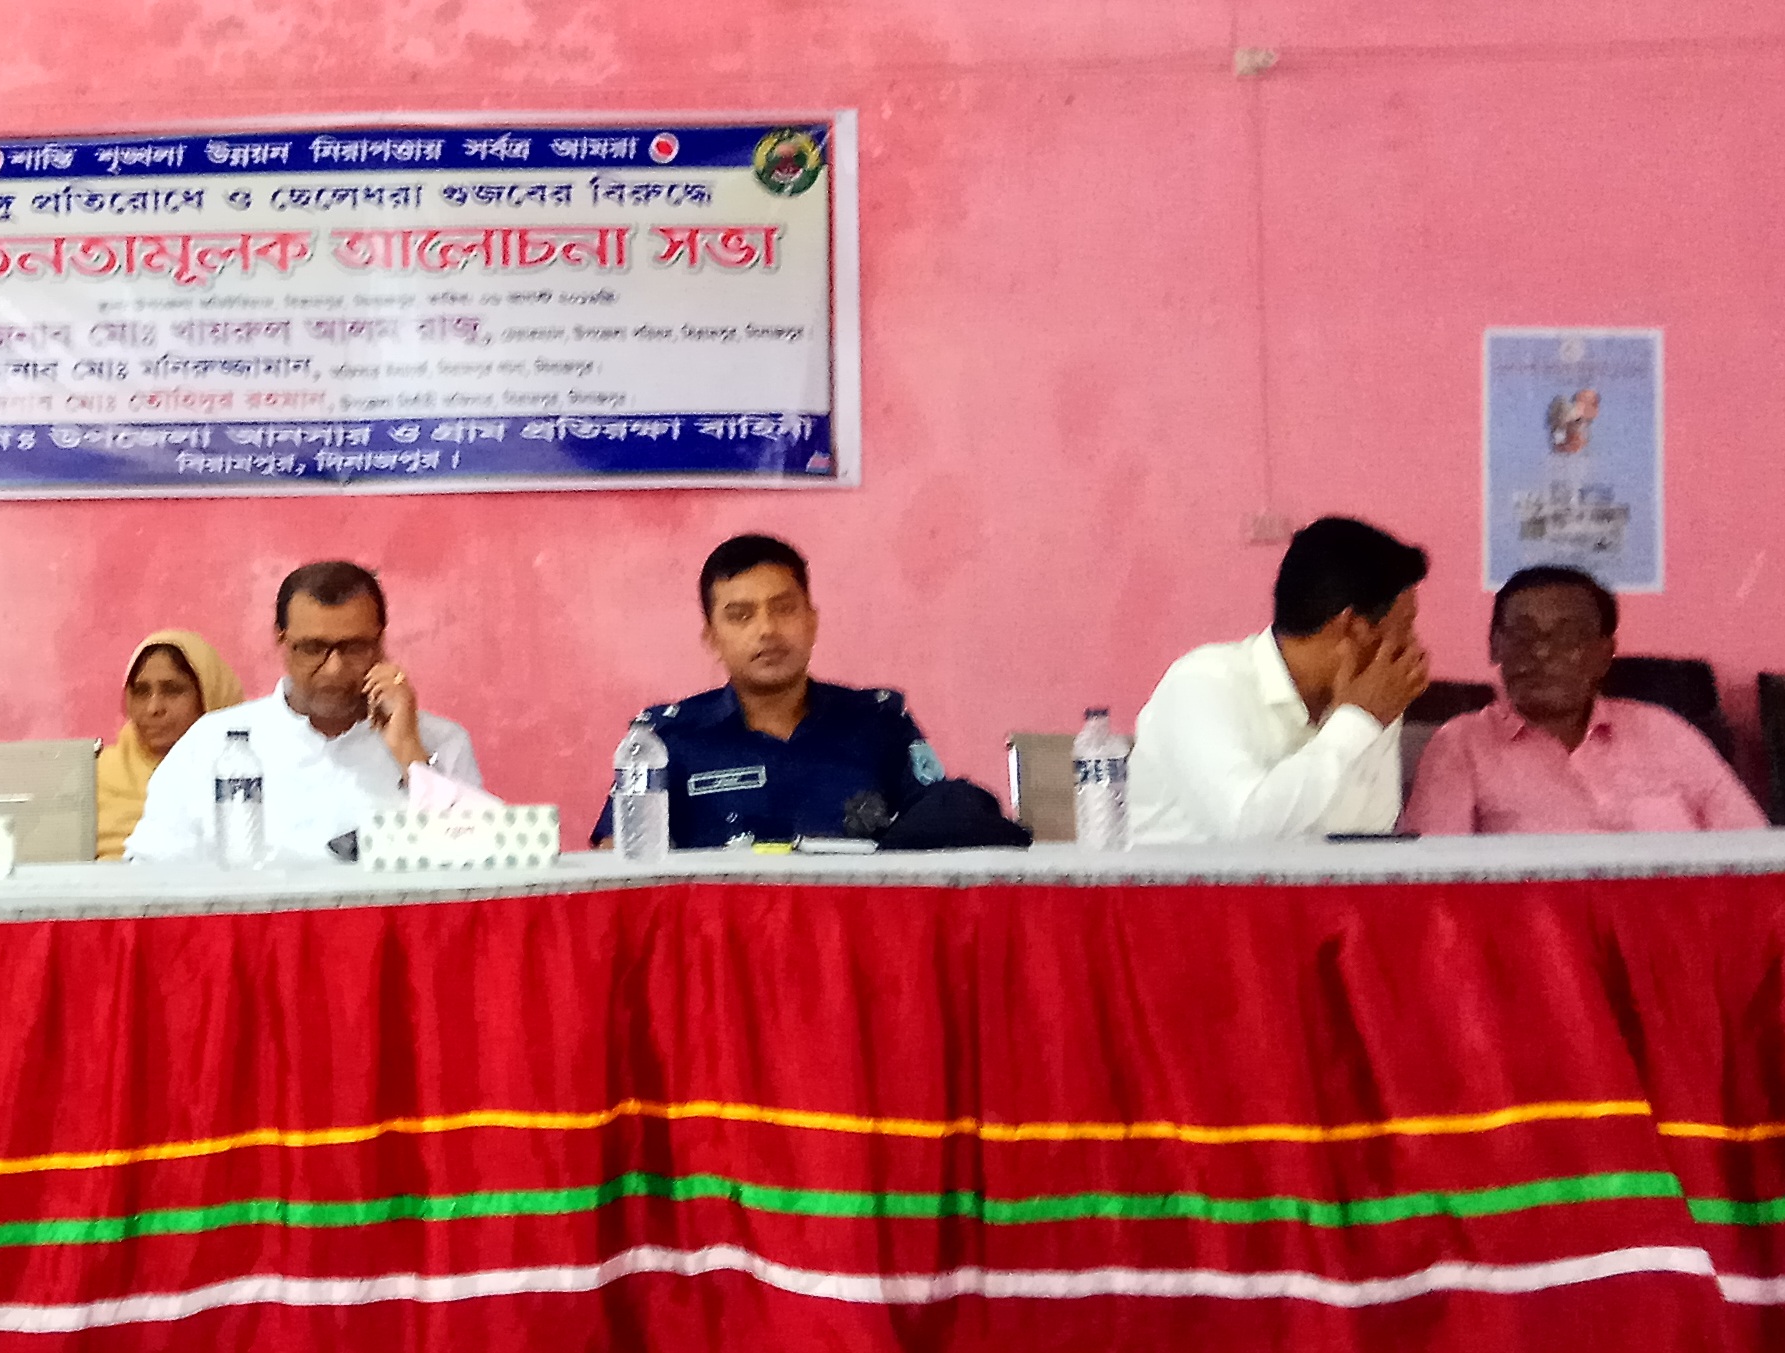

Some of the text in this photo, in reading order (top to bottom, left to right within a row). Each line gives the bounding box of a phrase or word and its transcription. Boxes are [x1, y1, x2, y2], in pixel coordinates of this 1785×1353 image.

[550, 136, 639, 161] আমরা
[31, 183, 205, 215] প্রতিরোধে
[227, 188, 253, 212] ও
[270, 183, 424, 214] ছেলেধরা
[442, 180, 573, 208] গুজবের
[589, 172, 713, 207] বিরুদ্ধে
[331, 223, 630, 272] আলোচনা
[651, 223, 779, 269] সভা
[47, 424, 212, 450] উপজেলা
[224, 419, 371, 450] আনসার
[388, 422, 420, 445] ও
[431, 420, 510, 445] গ্রাম
[521, 414, 685, 444] প্রতিরক্ষা
